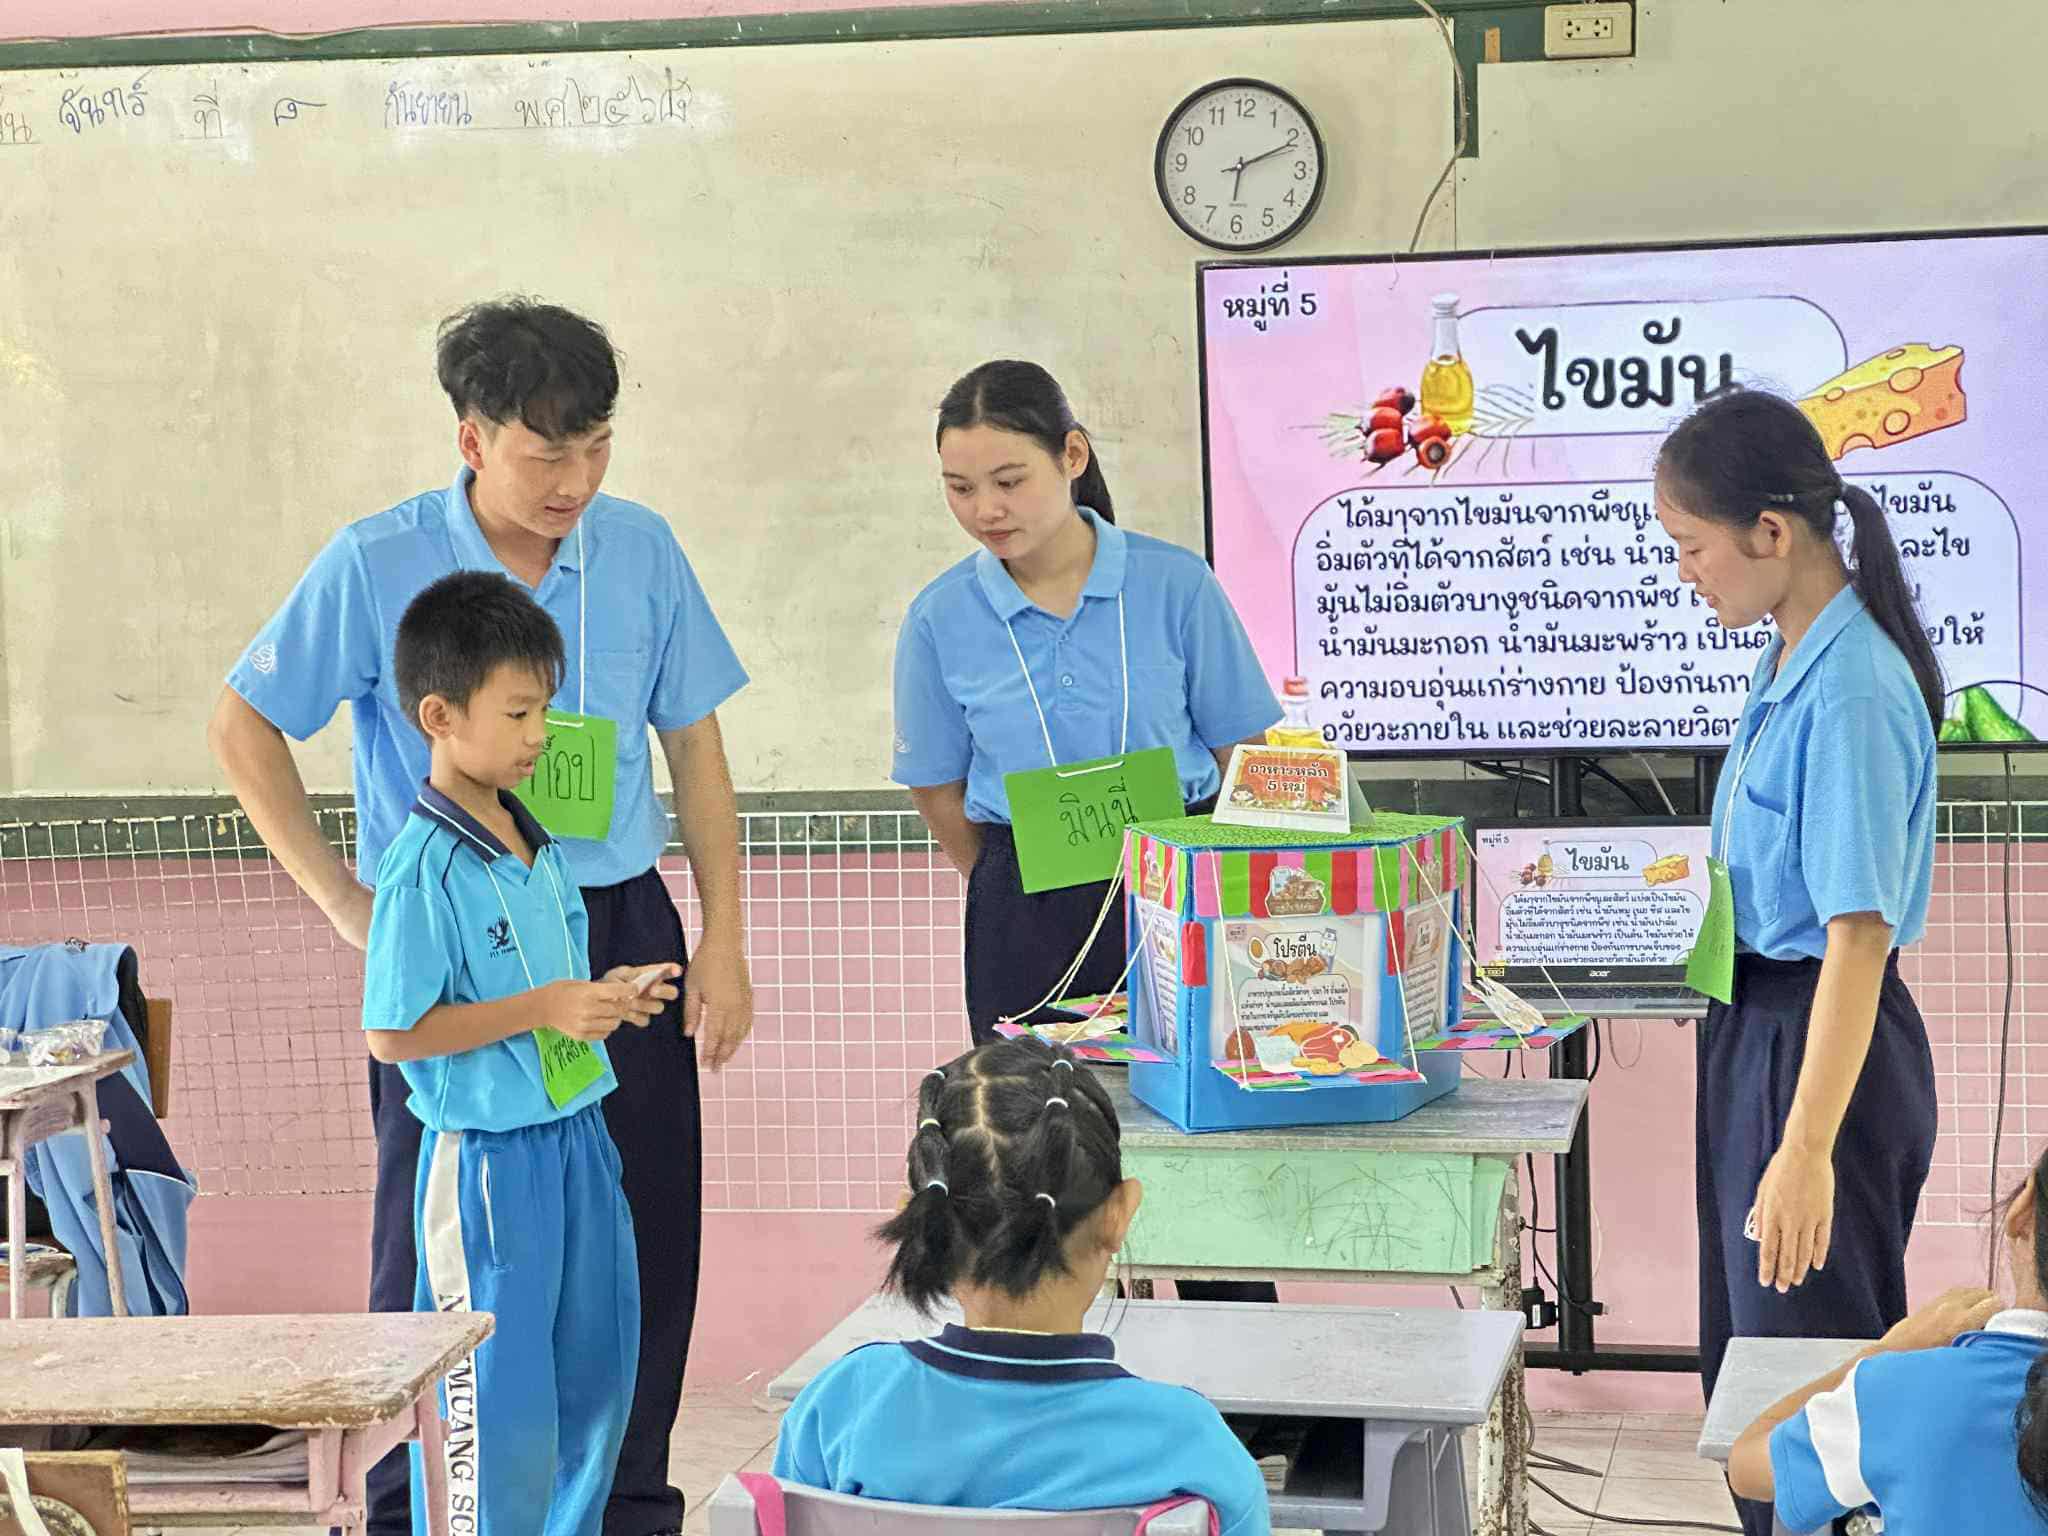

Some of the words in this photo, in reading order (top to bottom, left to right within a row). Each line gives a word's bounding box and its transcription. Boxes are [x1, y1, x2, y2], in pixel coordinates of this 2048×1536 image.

[193, 79, 223, 140] ที่
[1209, 106, 1225, 125] 11
[1234, 98, 1256, 118] 12
[1270, 109, 1277, 128] 1
[1184, 126, 1204, 146] 10
[1287, 128, 1299, 147] 2
[1175, 153, 1187, 172] 9
[1294, 161, 1306, 180] 3
[1183, 185, 1196, 205] 8
[1283, 188, 1294, 207] 4
[1204, 205, 1217, 224] 7
[1230, 214, 1243, 234] 6
[1261, 207, 1274, 227] 5
[1223, 270, 1290, 331] หมู่ที่
[1300, 293, 1317, 316] 5
[1515, 316, 1738, 410] ไขมัน
[1337, 488, 1659, 530] ได้มาจากไขมันจากพืชแ
[1872, 481, 1957, 513] ไขมัน
[1315, 528, 1552, 571] อิ่มตัวที่ได้จากสัตว์
[1561, 535, 1616, 568] เช่น
[1624, 521, 1680, 565] น้ำม
[1900, 528, 1970, 558] ละไข
[1317, 573, 1681, 614] มันไม่อิ่มตัวบางชนิดจากพืช
[1318, 614, 1488, 656] น้ำมันมะกอก
[1498, 610, 1687, 653] น้ำมันมะพร้าว
[1698, 616, 1773, 650] เป็นต้
[1928, 612, 1985, 645] ยให้
[1321, 665, 1606, 711] ความอบอุ่นแก่ร่างกาย
[1616, 661, 1750, 694] ป้องกันกา
[1322, 708, 1489, 742] อวัยวะภายใน
[1249, 762, 1328, 777] อาหารหลัก
[1267, 780, 1277, 791] 5
[1282, 777, 1306, 798] หมู่
[1565, 846, 1630, 871] ไขมัน
[1273, 933, 1317, 958] โปรตีน
[447, 1352, 476, 1480] MUANG
